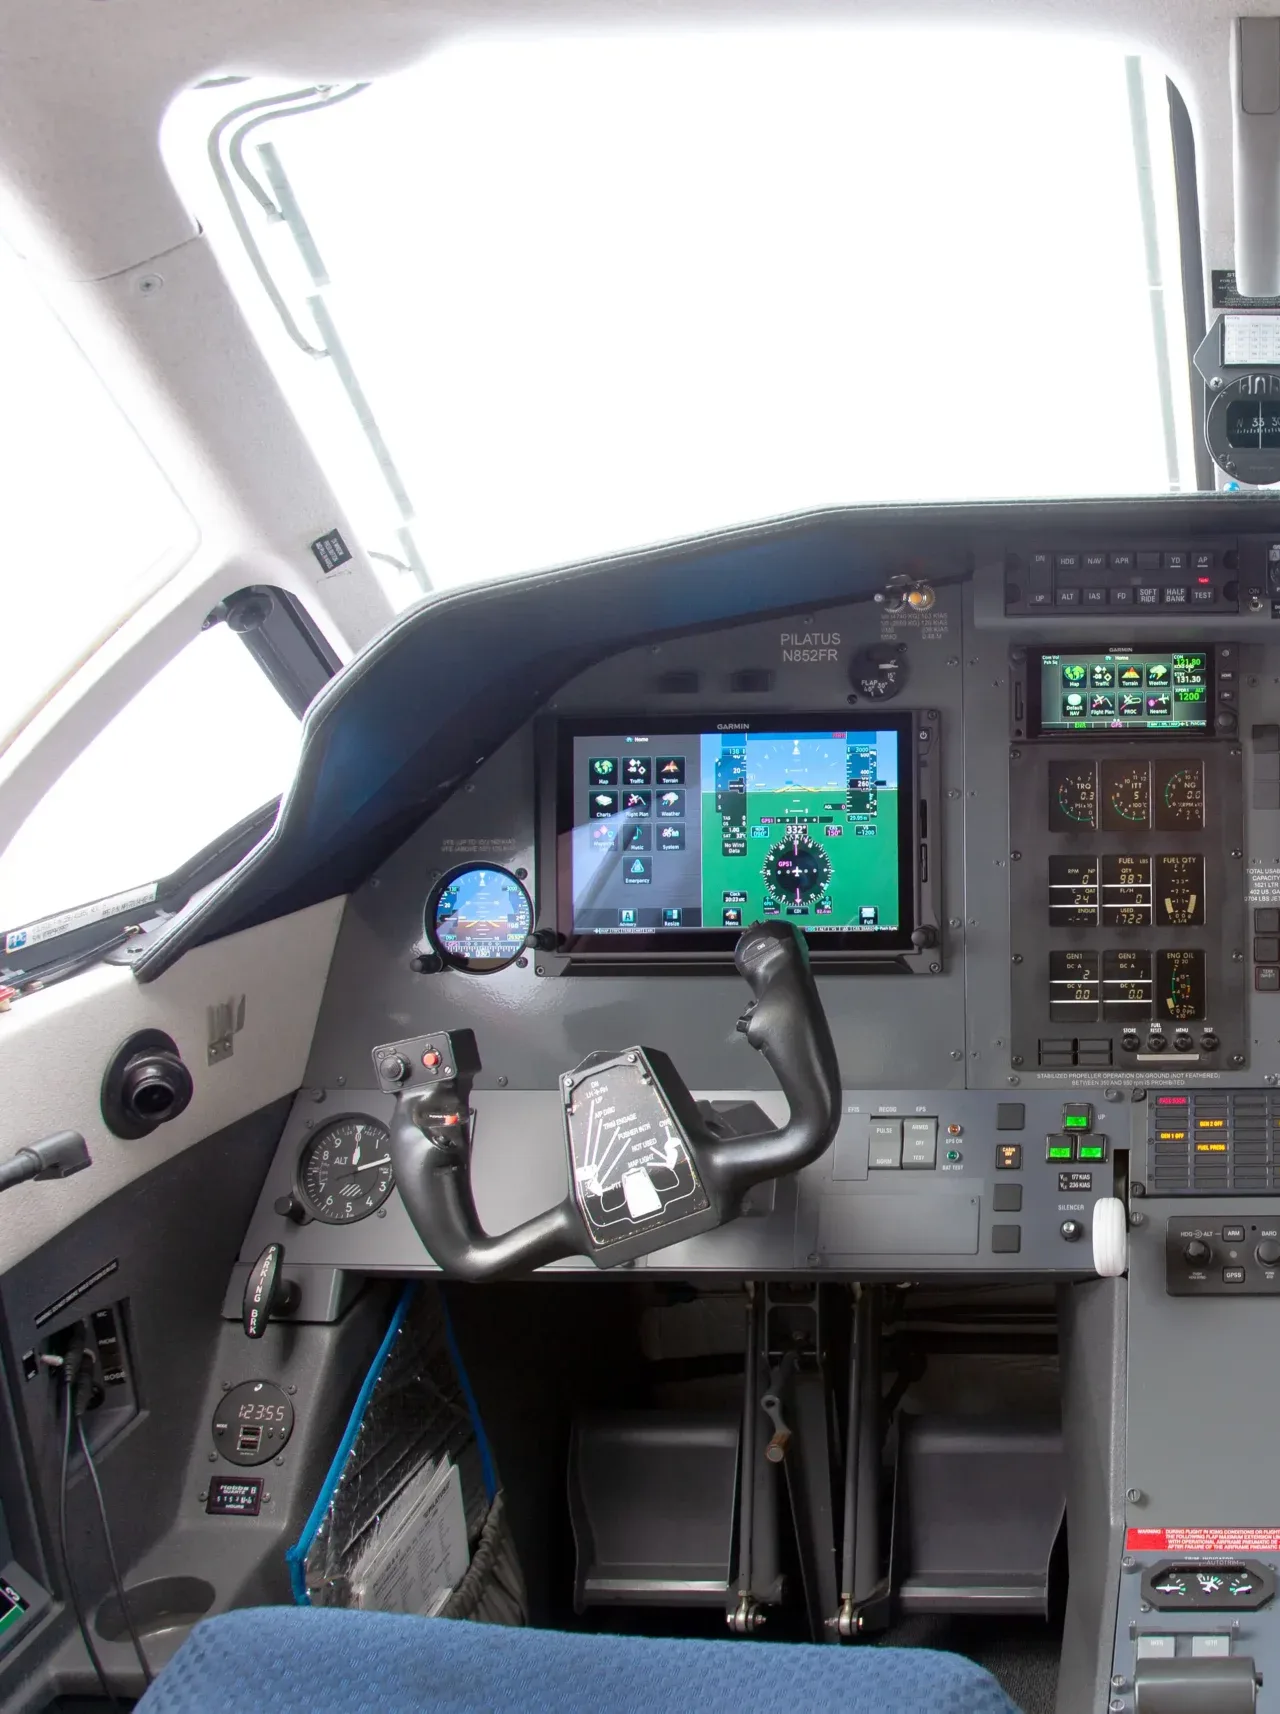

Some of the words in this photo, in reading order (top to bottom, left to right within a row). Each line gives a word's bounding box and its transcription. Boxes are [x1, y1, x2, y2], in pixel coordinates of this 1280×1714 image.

[1252, 418, 1265, 427] 33
[780, 633, 840, 645] PILATUS
[783, 649, 838, 662] N852FR
[1120, 875, 1142, 884] 987
[254, 1246, 276, 1302] PARKING
[249, 1309, 258, 1334] BRK
[104, 1371, 126, 1381] BOSE
